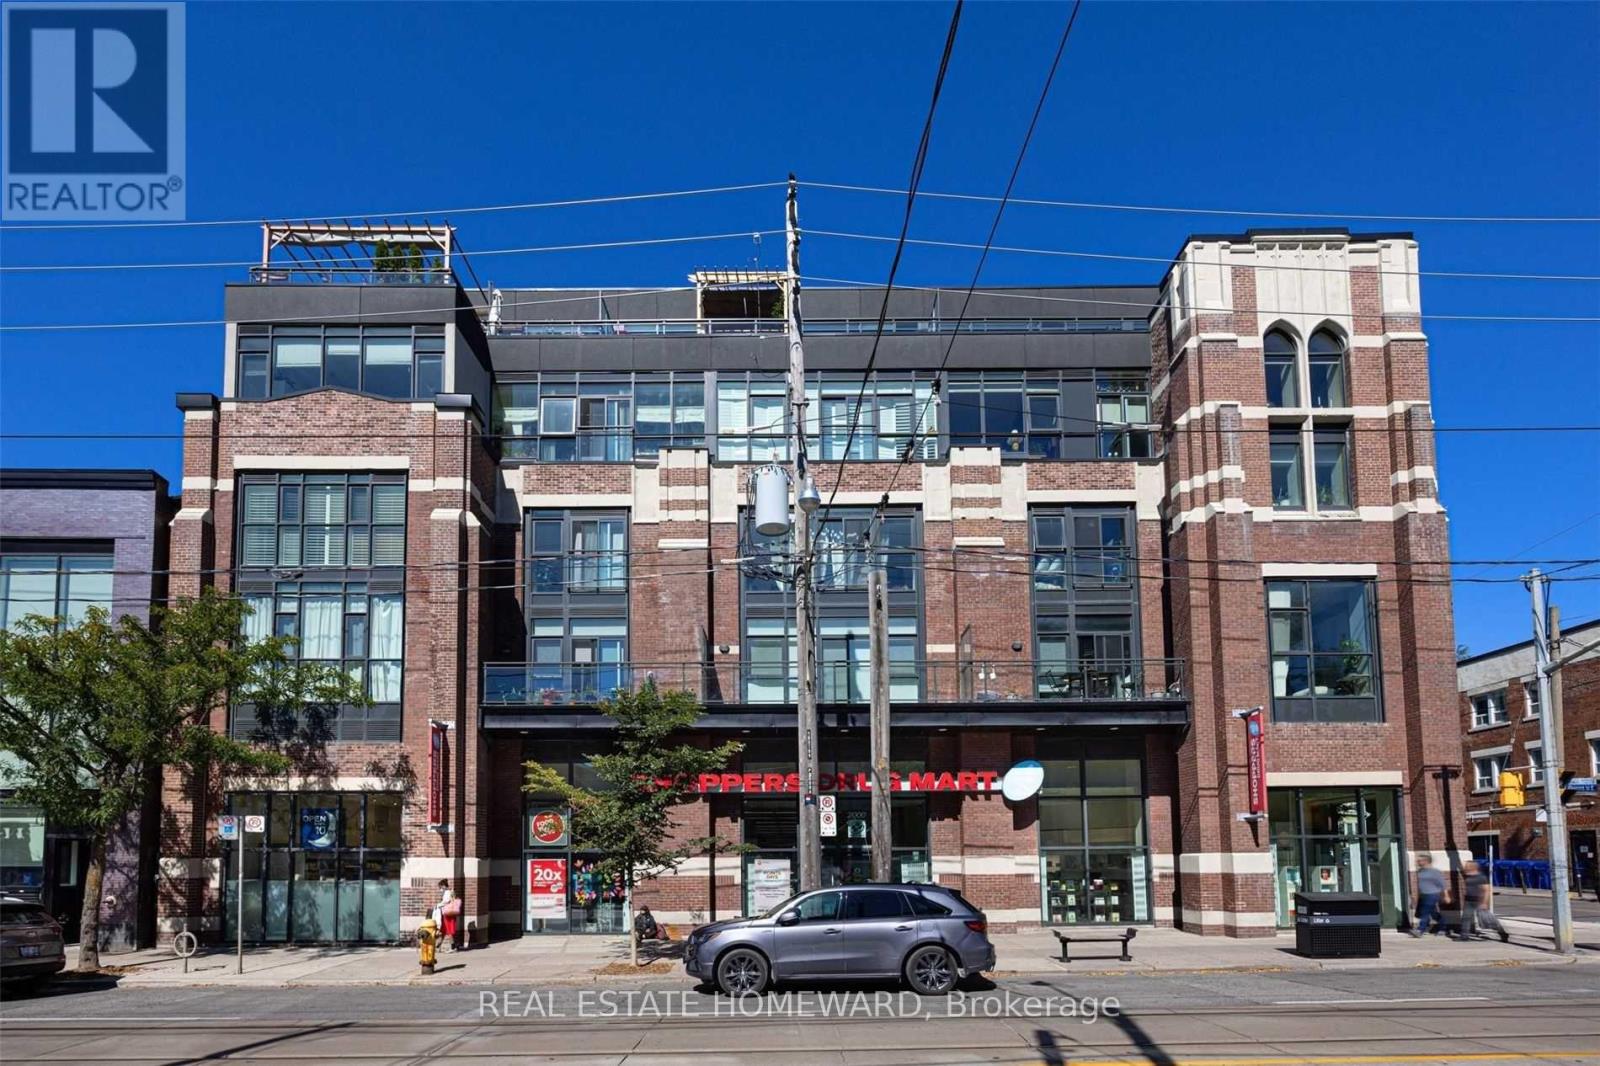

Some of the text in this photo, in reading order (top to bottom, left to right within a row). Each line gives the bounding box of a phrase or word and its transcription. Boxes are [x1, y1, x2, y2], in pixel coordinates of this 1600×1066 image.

[630, 772, 800, 793] PPERS
[909, 771, 997, 792] MART
[303, 815, 327, 823] OPEN
[534, 868, 562, 881] 20x
